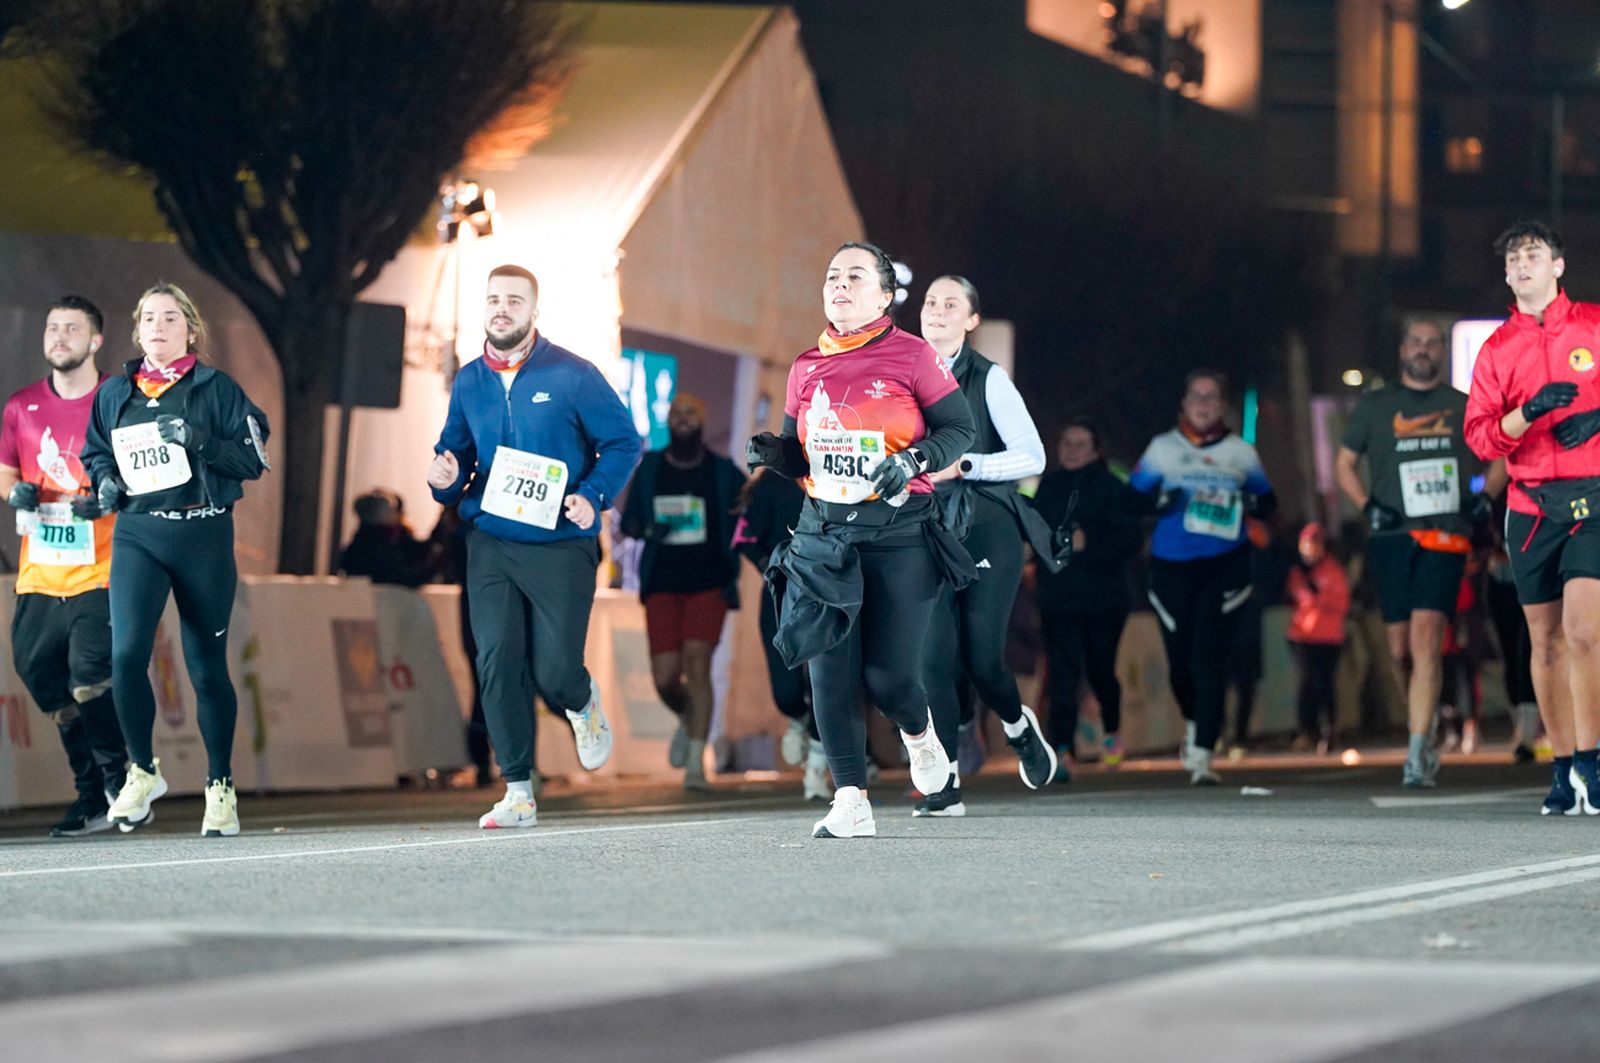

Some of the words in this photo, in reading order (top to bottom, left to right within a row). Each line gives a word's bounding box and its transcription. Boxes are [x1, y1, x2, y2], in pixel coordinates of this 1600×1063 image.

[130, 445, 170, 470] 2738
[50, 462, 65, 480] 43
[502, 474, 549, 502] 2739
